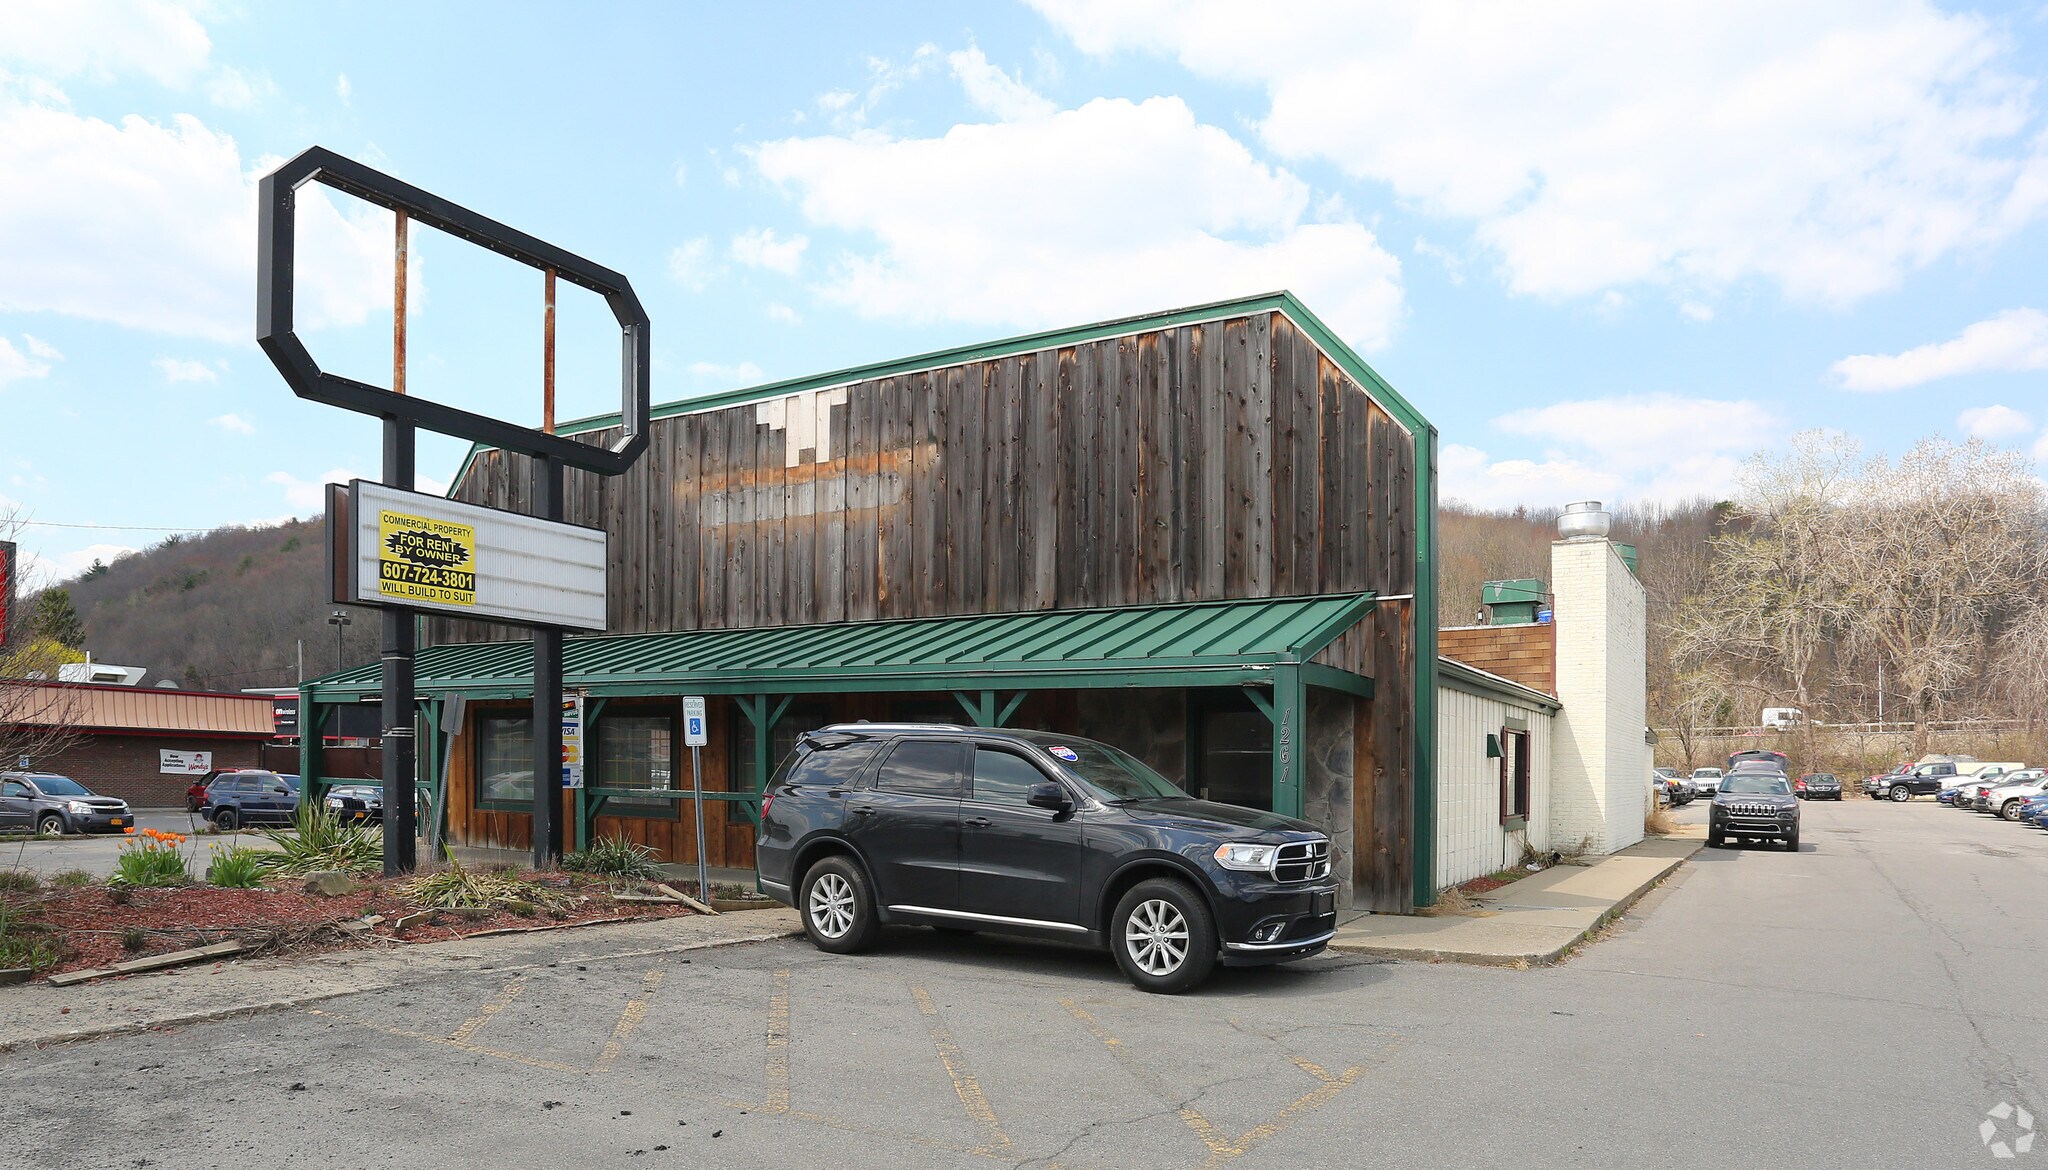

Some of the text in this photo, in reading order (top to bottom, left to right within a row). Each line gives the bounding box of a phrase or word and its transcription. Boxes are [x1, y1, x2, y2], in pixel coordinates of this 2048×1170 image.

[383, 514, 471, 538] COMMERCIAL PROPERTY
[395, 544, 461, 562] BY OWNER
[400, 533, 456, 553] FOR RENT
[382, 561, 473, 590] 607-724-3801
[382, 581, 474, 603] WILL BUILD TO SUIT
[686, 709, 703, 717] PARKING
[1279, 707, 1291, 783] 1261
